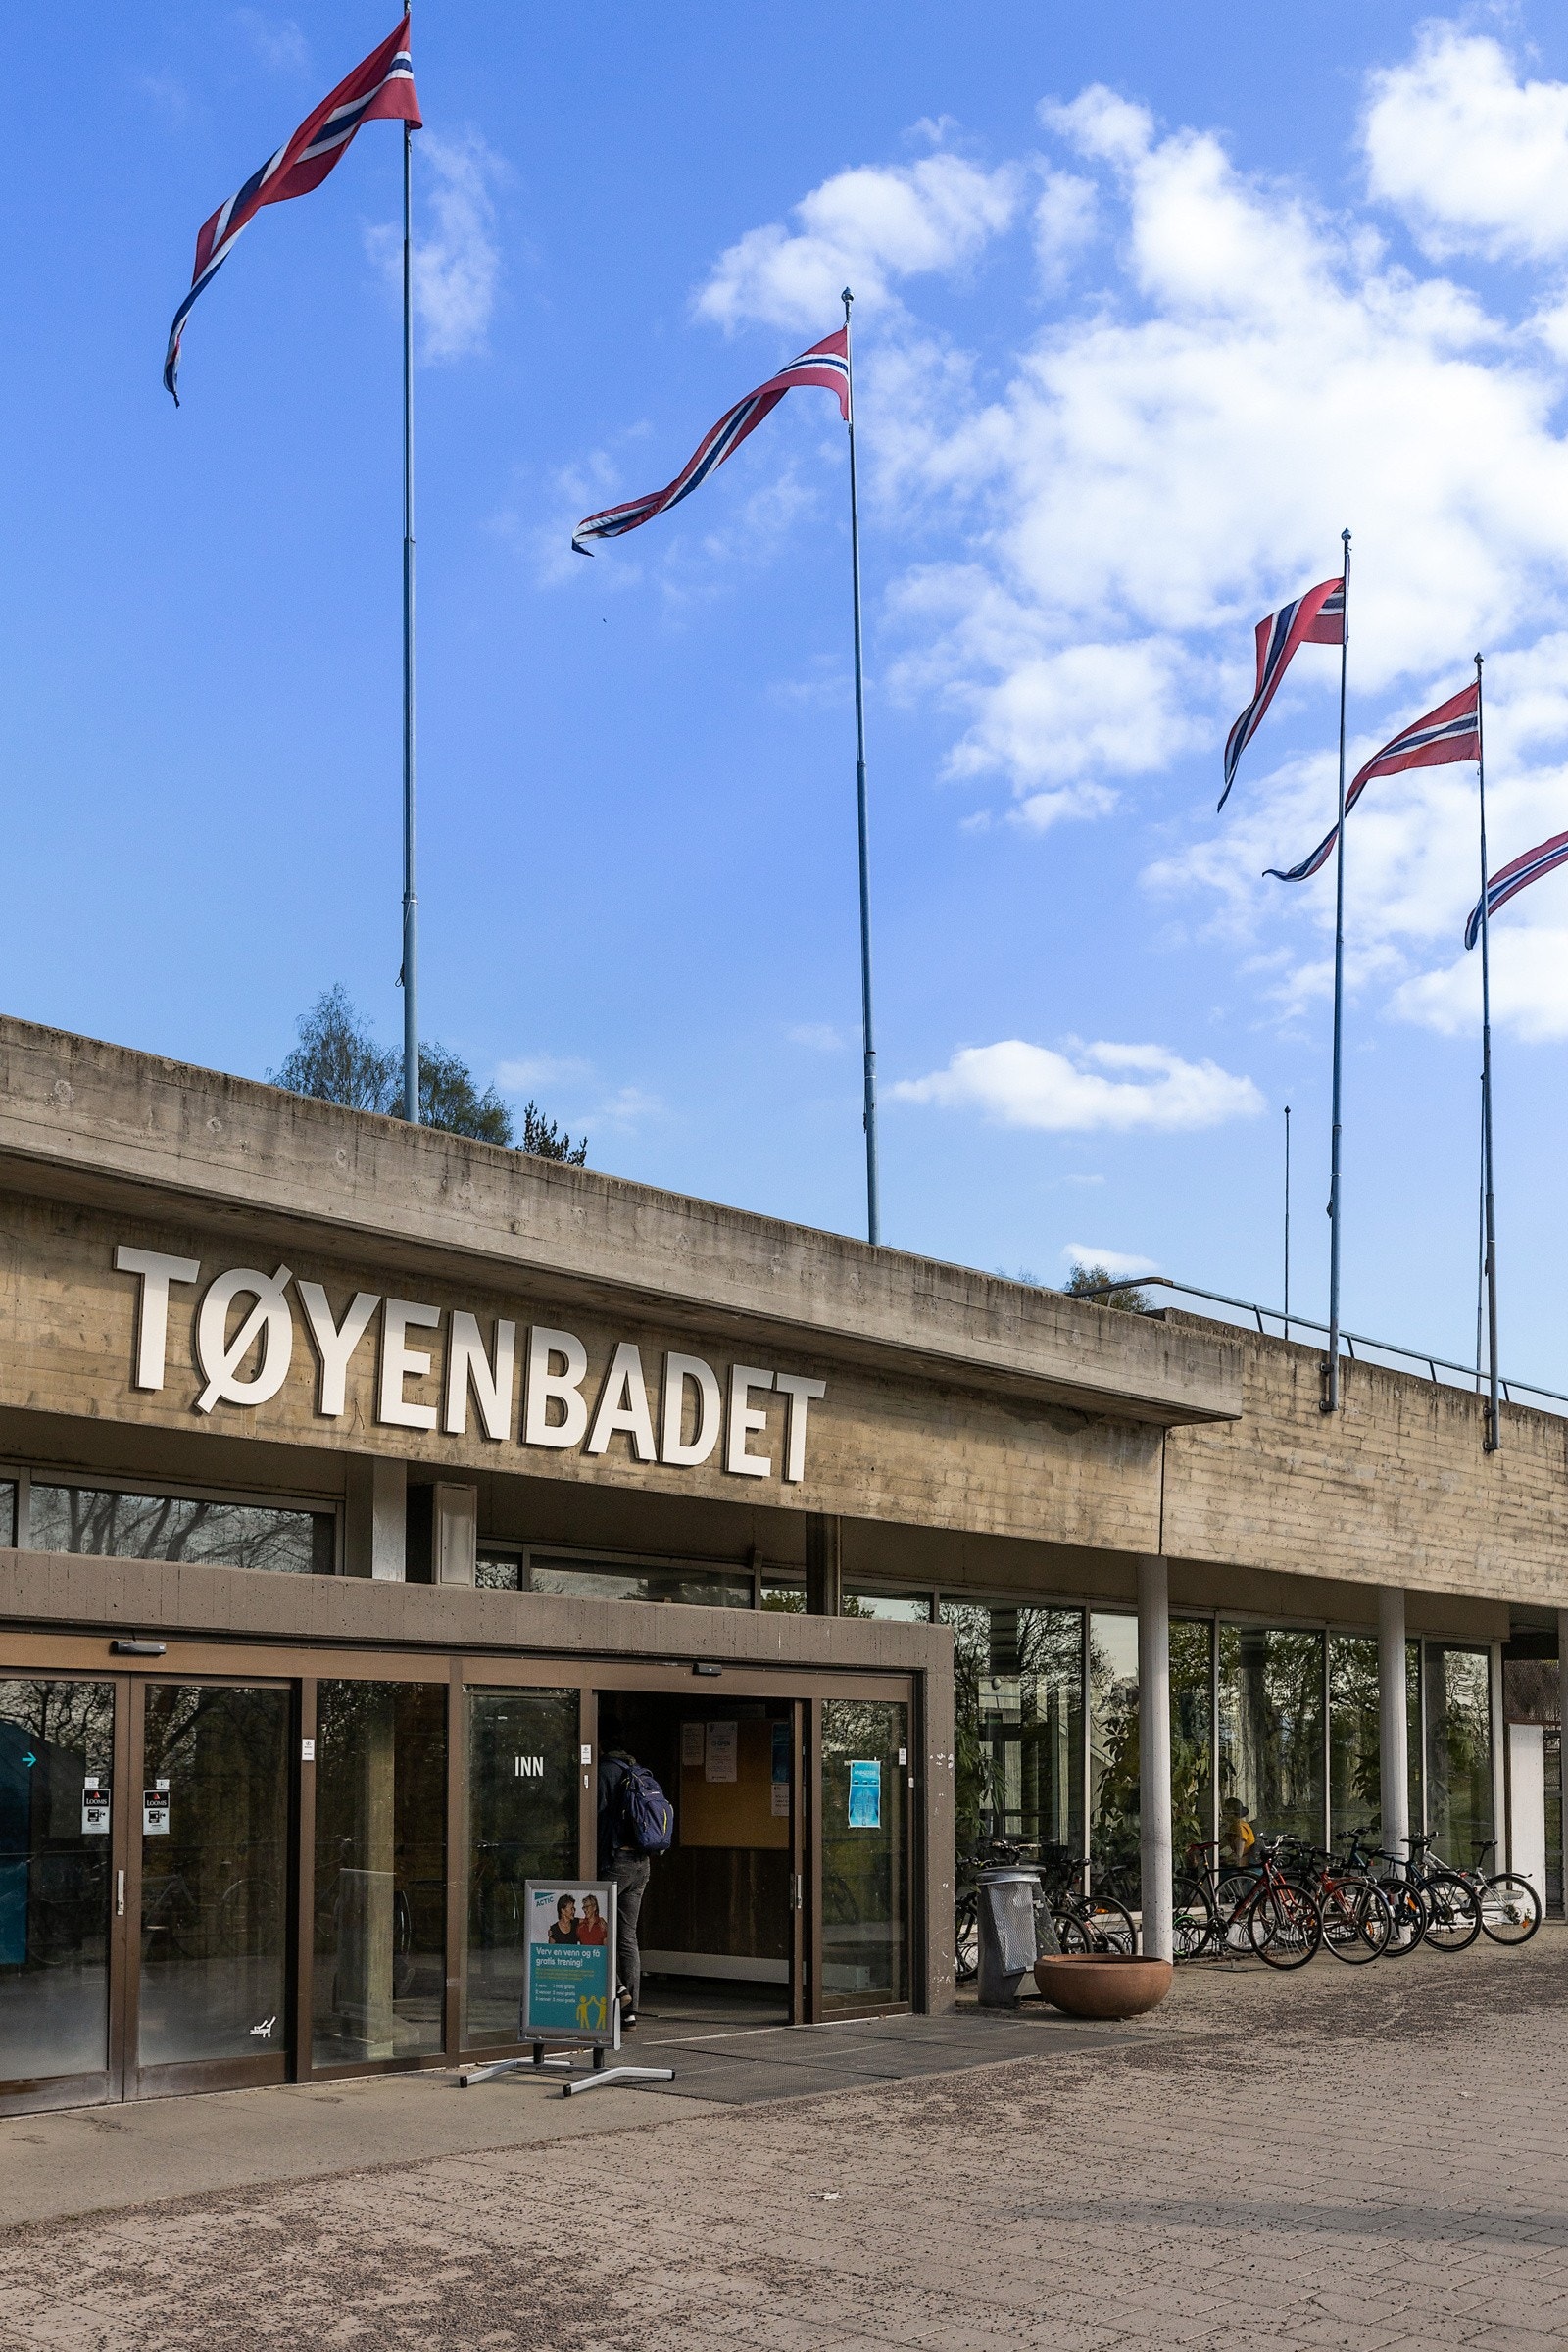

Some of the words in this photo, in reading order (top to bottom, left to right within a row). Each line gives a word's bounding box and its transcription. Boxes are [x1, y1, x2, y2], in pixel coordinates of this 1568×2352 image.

[114, 1245, 826, 1482] TØYENBADET
[515, 1756, 543, 1776] INN
[536, 1896, 554, 1907] ACTIC
[535, 1957, 556, 1966] gratis
[557, 1958, 583, 1968] trening!
